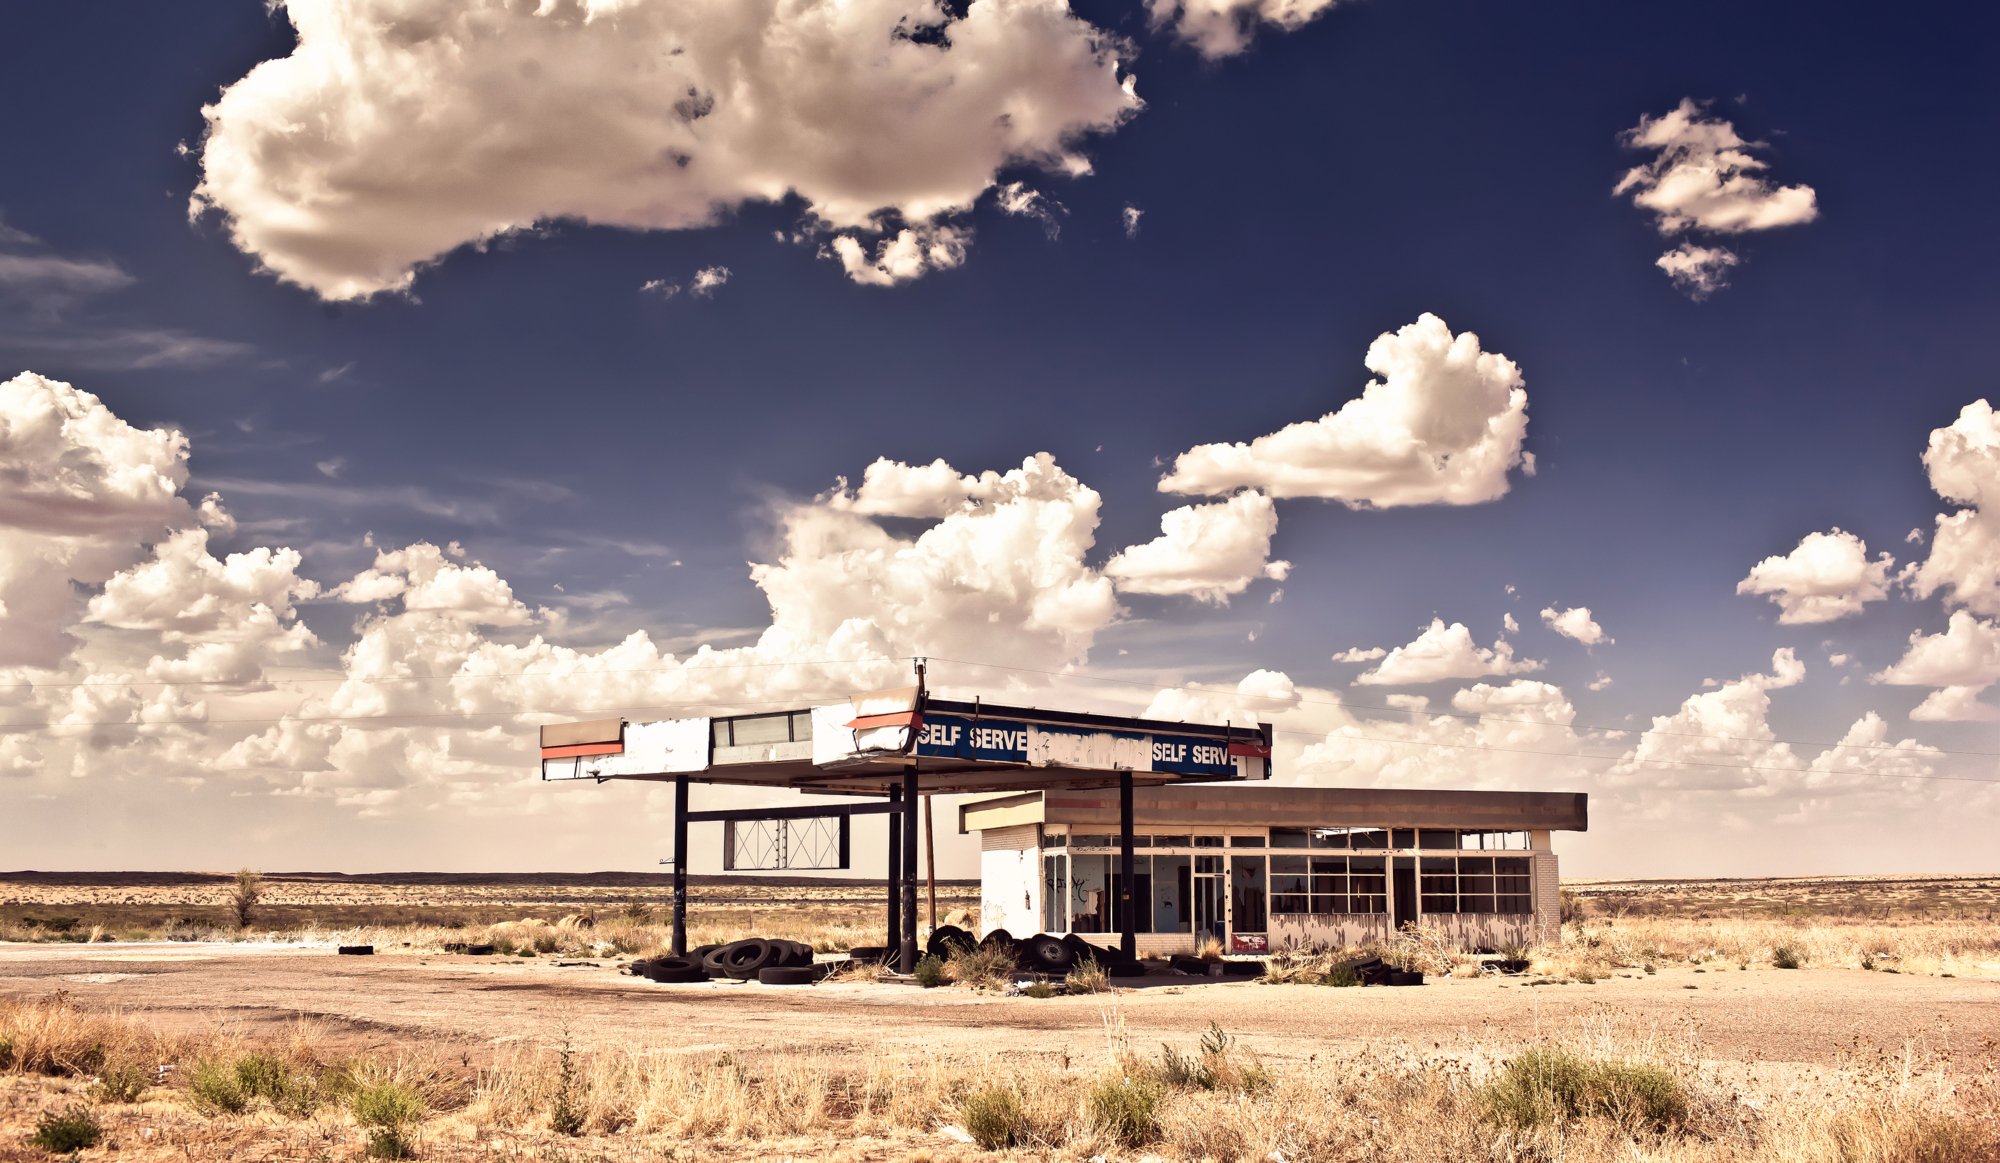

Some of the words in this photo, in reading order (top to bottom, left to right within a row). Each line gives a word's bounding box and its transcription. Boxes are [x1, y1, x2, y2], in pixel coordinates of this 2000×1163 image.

[917, 723, 961, 746] SELF
[969, 727, 1027, 751] SERVE
[1152, 742, 1187, 762] SELF
